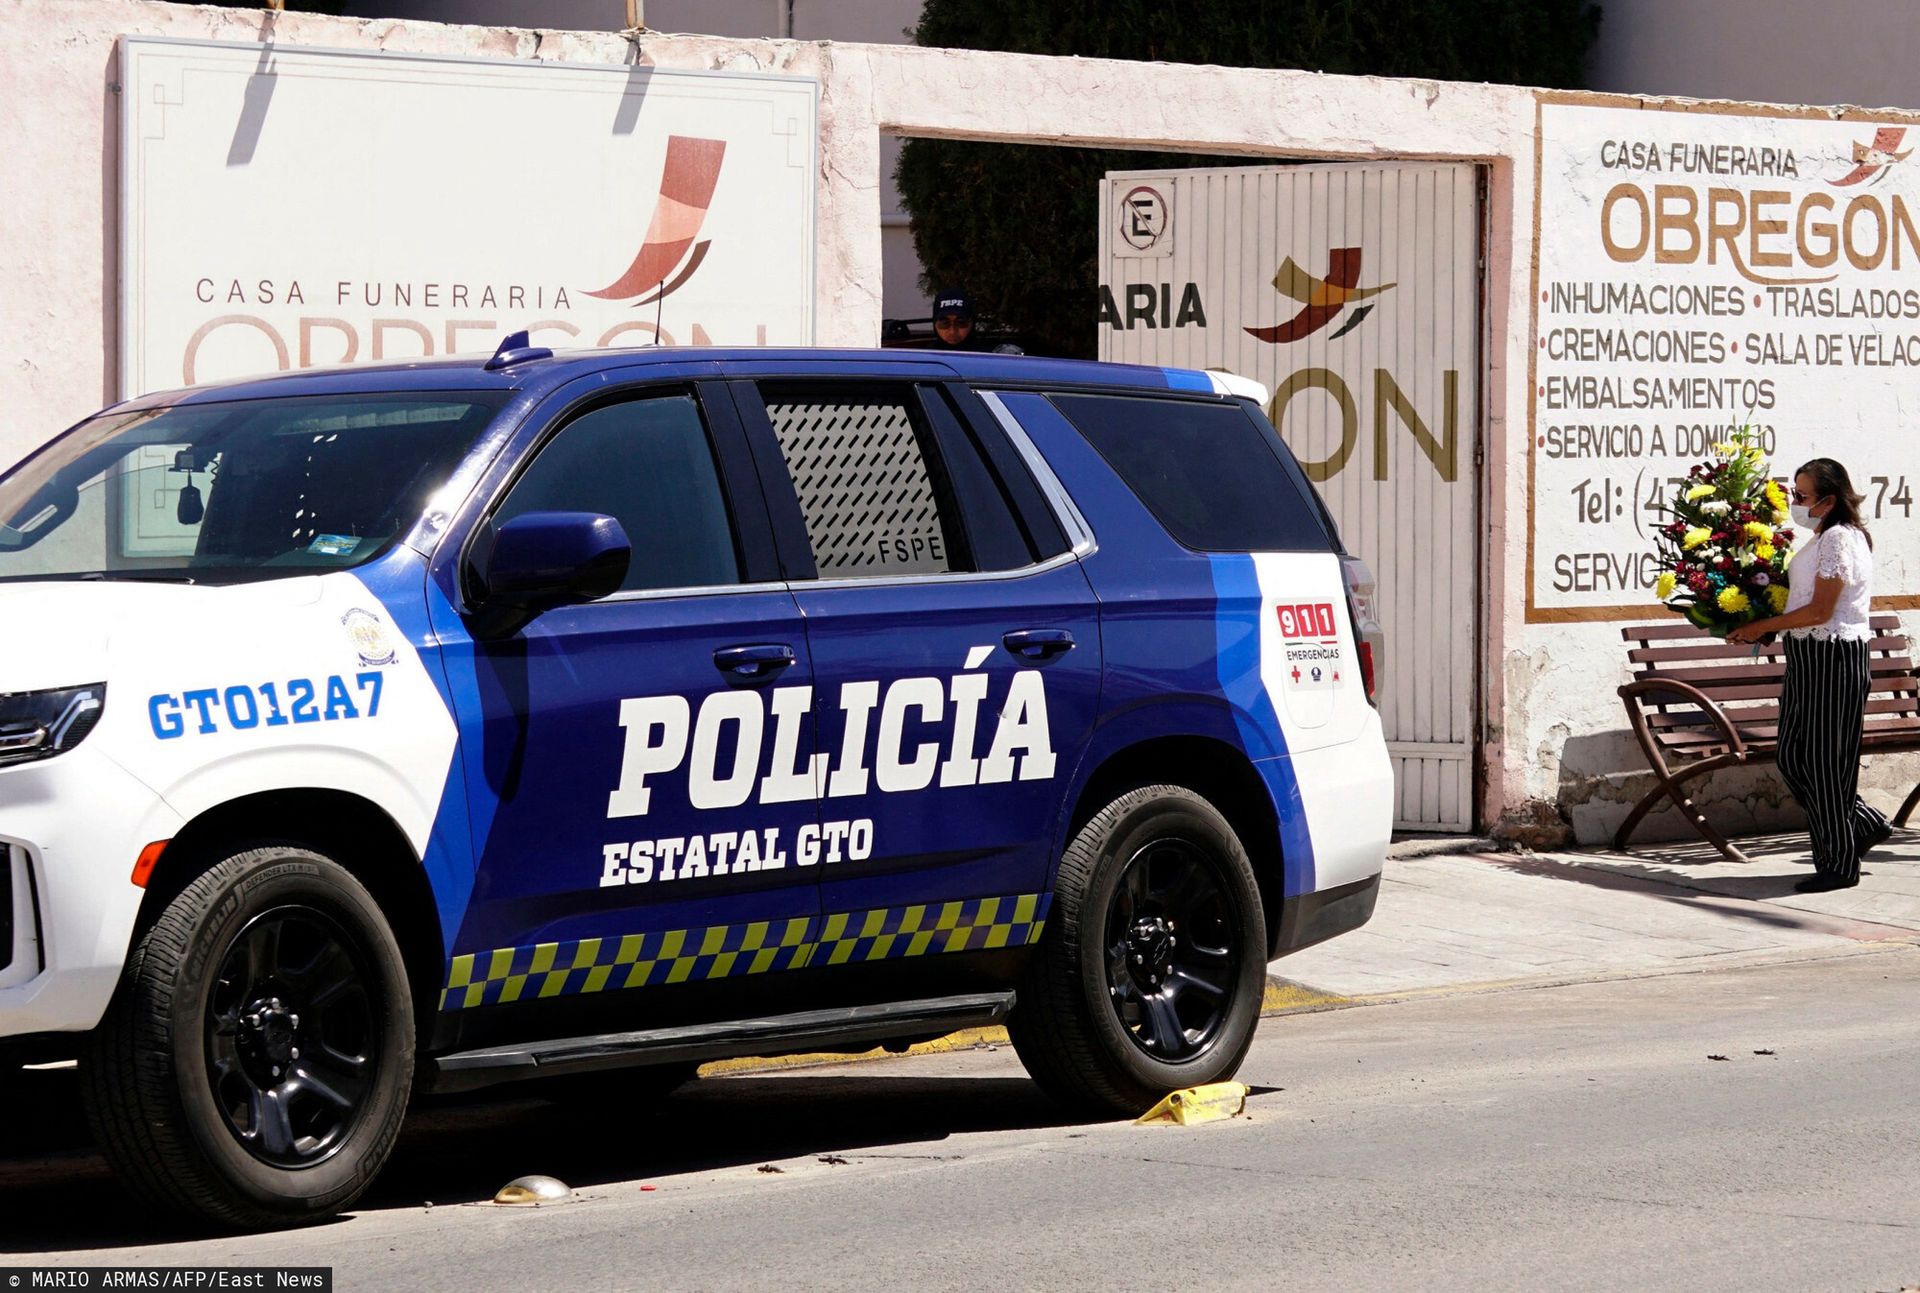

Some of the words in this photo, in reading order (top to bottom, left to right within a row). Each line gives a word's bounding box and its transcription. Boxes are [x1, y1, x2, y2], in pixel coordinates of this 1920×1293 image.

[1601, 139, 1662, 171] CASA
[1669, 142, 1799, 177] FUNERARIA
[196, 278, 304, 304] CASA
[337, 281, 571, 309] FUNERARIA
[1098, 282, 1207, 330] ARIA
[1551, 281, 1745, 316] INHUMACIONES
[1766, 286, 1920, 319] TRASLADOS
[1548, 327, 1726, 364] CREMACIONES
[1745, 332, 1810, 365] SALA
[1815, 334, 1843, 366] DE
[1546, 376, 1776, 409] EMBALSAMIENTOS
[1204, 367, 1459, 482] ON
[1545, 424, 1643, 458] SERVICIO
[1650, 424, 1667, 458] A
[1571, 477, 1623, 524] Tel:
[878, 536, 944, 563] FSPE
[1553, 552, 1681, 592] SERVIC
[1280, 607, 1332, 635] 911
[1286, 649, 1340, 660] EMERGENCIAS
[148, 671, 384, 740] GTO12A7
[607, 645, 1057, 818] POLICÍA
[600, 827, 786, 887] ESTATAL
[796, 818, 873, 866] GTO
